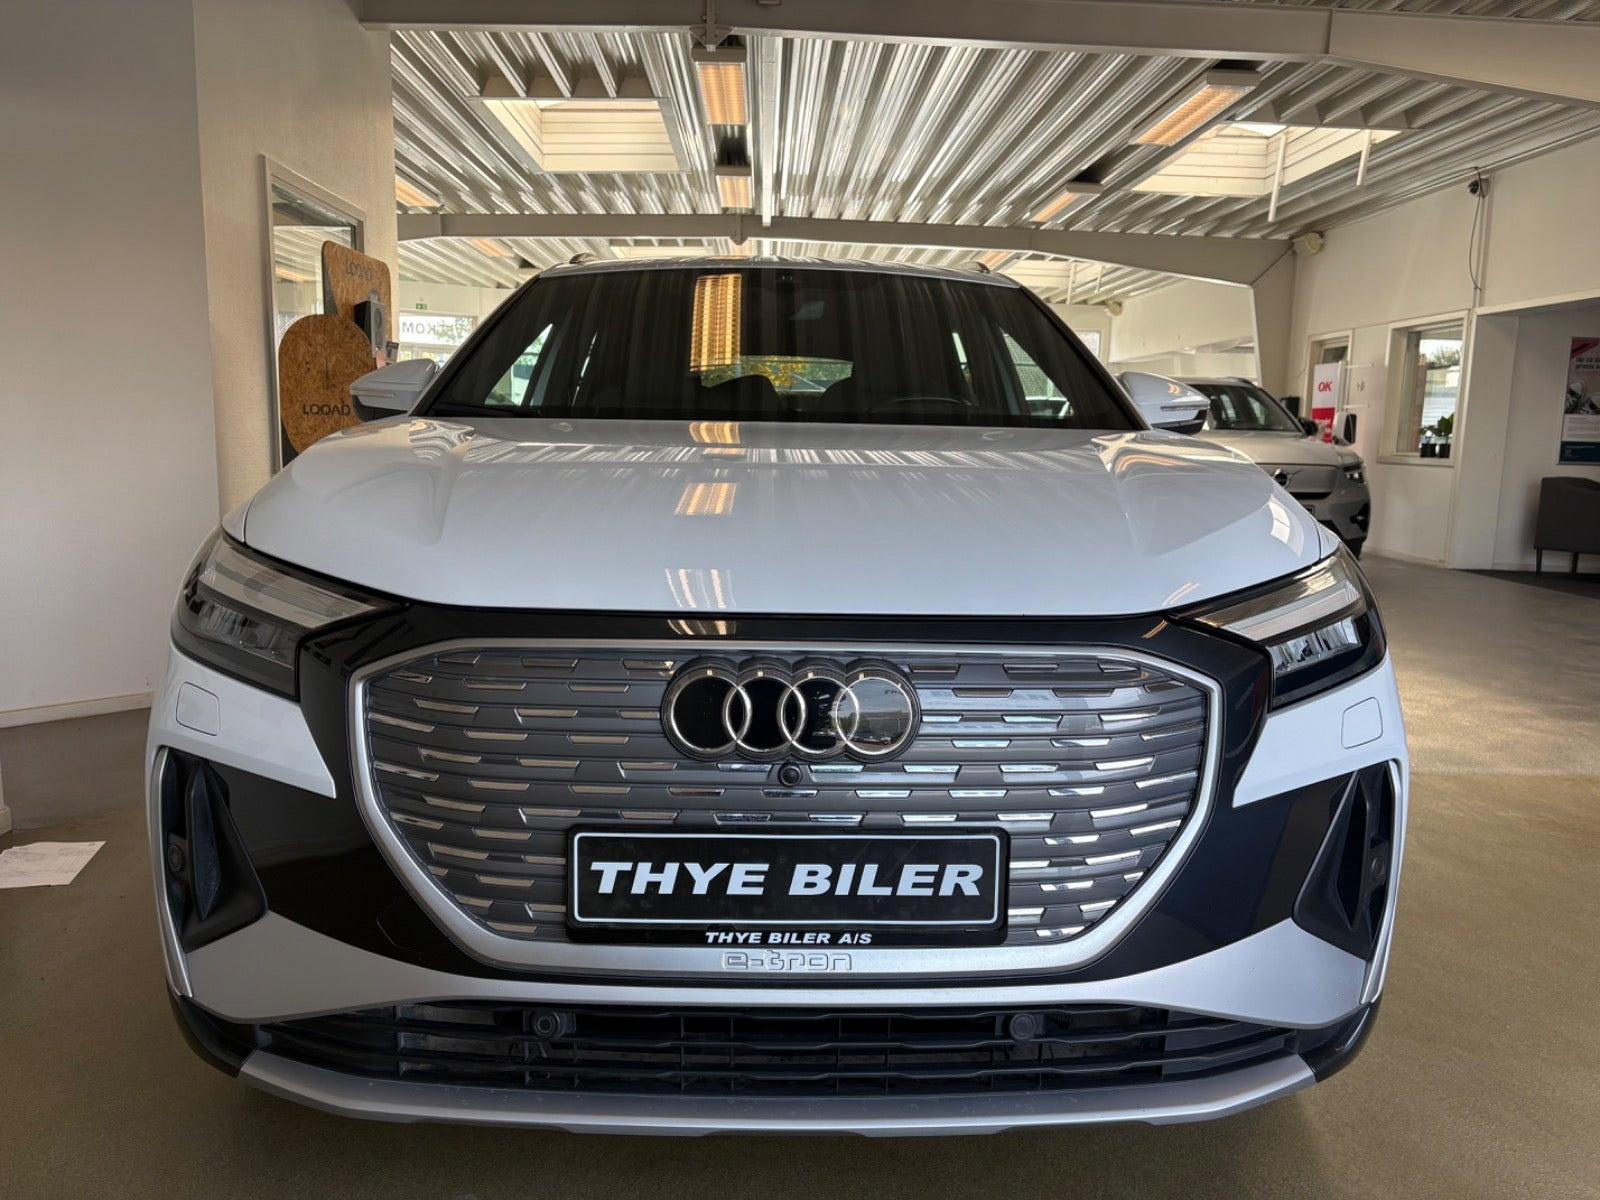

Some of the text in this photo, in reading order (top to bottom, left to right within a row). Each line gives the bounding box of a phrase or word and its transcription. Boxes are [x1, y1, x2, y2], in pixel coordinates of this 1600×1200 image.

[1318, 381, 1332, 392] OK
[303, 403, 350, 416] LOOAD
[590, 861, 984, 896] THYE BILER
[705, 932, 872, 944] THYE BILER A/S
[722, 950, 852, 971] e-tron
